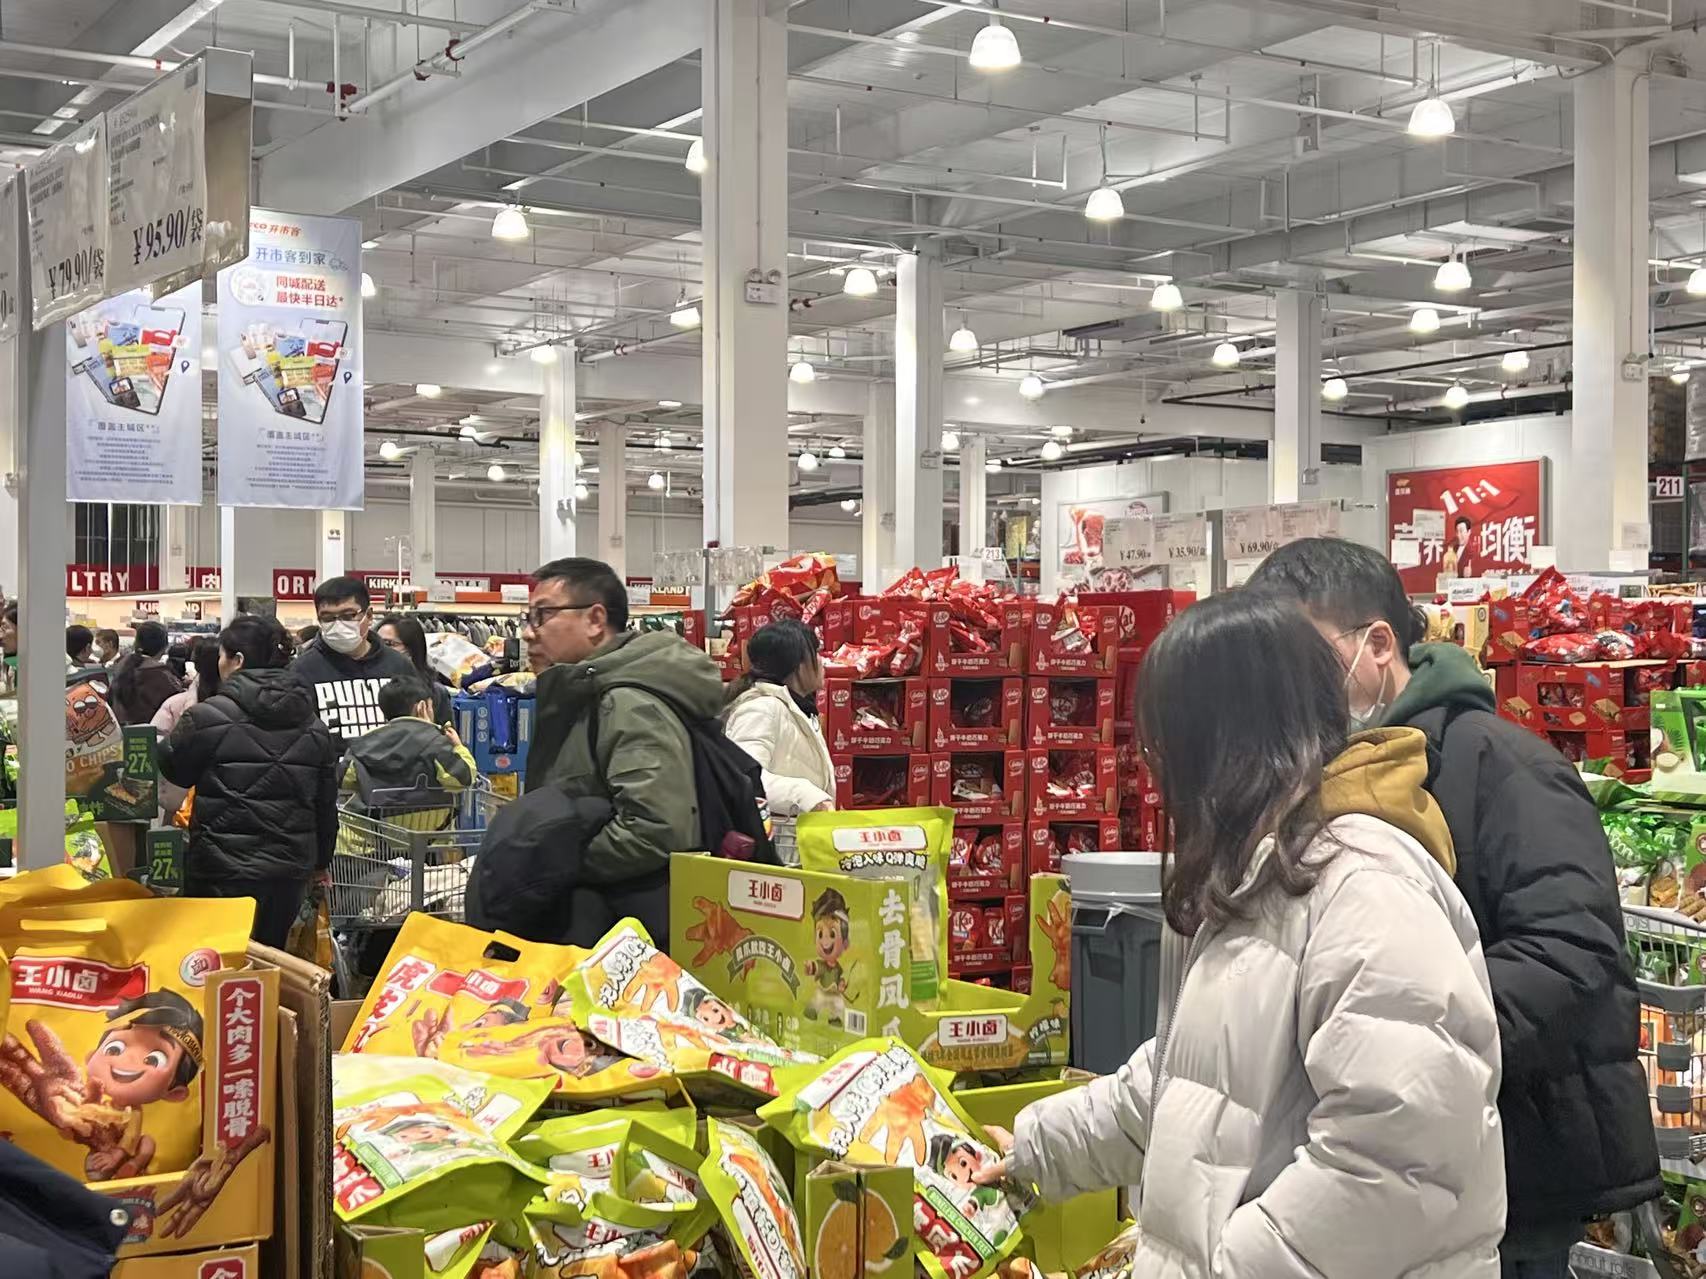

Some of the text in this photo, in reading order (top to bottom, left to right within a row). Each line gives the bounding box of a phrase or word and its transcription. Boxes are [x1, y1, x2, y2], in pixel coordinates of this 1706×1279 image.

[268, 224, 302, 237] 开市客
[255, 247, 326, 265] 开市客到家
[276, 275, 326, 291] 同城配送
[1440, 479, 1500, 515] 1:1:1
[1658, 478, 1681, 496] 211
[1480, 515, 1536, 566] 均衡
[985, 549, 1000, 559] 213
[71, 570, 128, 593] LTRY
[277, 575, 317, 595] ORK
[80, 744, 118, 768] CHIPS
[859, 831, 901, 843] 王小卤
[748, 878, 783, 903] 王小卤
[15, 965, 99, 994] 王小卤
[466, 971, 500, 994] 小卤
[949, 1020, 997, 1038] 王小卤
[223, 986, 256, 1138] 个大肉多一嗦脱骨
[587, 1149, 616, 1169] 王小
[585, 1222, 623, 1242] 王小
